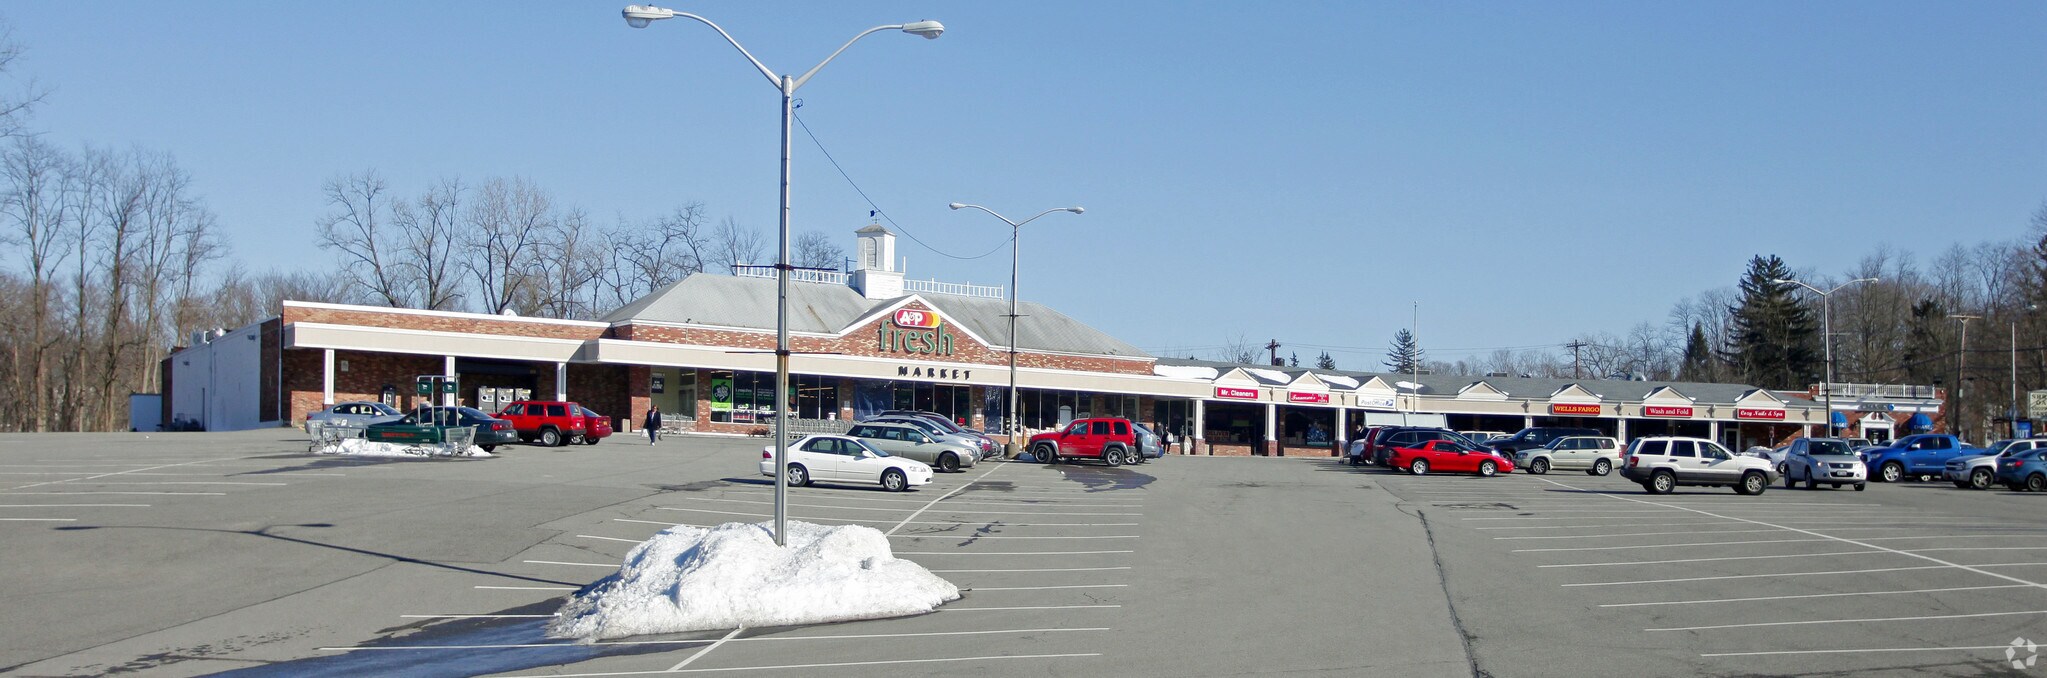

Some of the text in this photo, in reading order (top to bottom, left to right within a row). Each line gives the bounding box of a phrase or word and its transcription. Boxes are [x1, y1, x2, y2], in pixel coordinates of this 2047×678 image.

[900, 310, 923, 326] A&P
[878, 319, 954, 356] fresh
[898, 366, 971, 380] MARKET
[1231, 389, 1254, 398] Cleaners
[1554, 405, 1600, 413] WELLS FARGO
[1650, 407, 1665, 415] Wash
